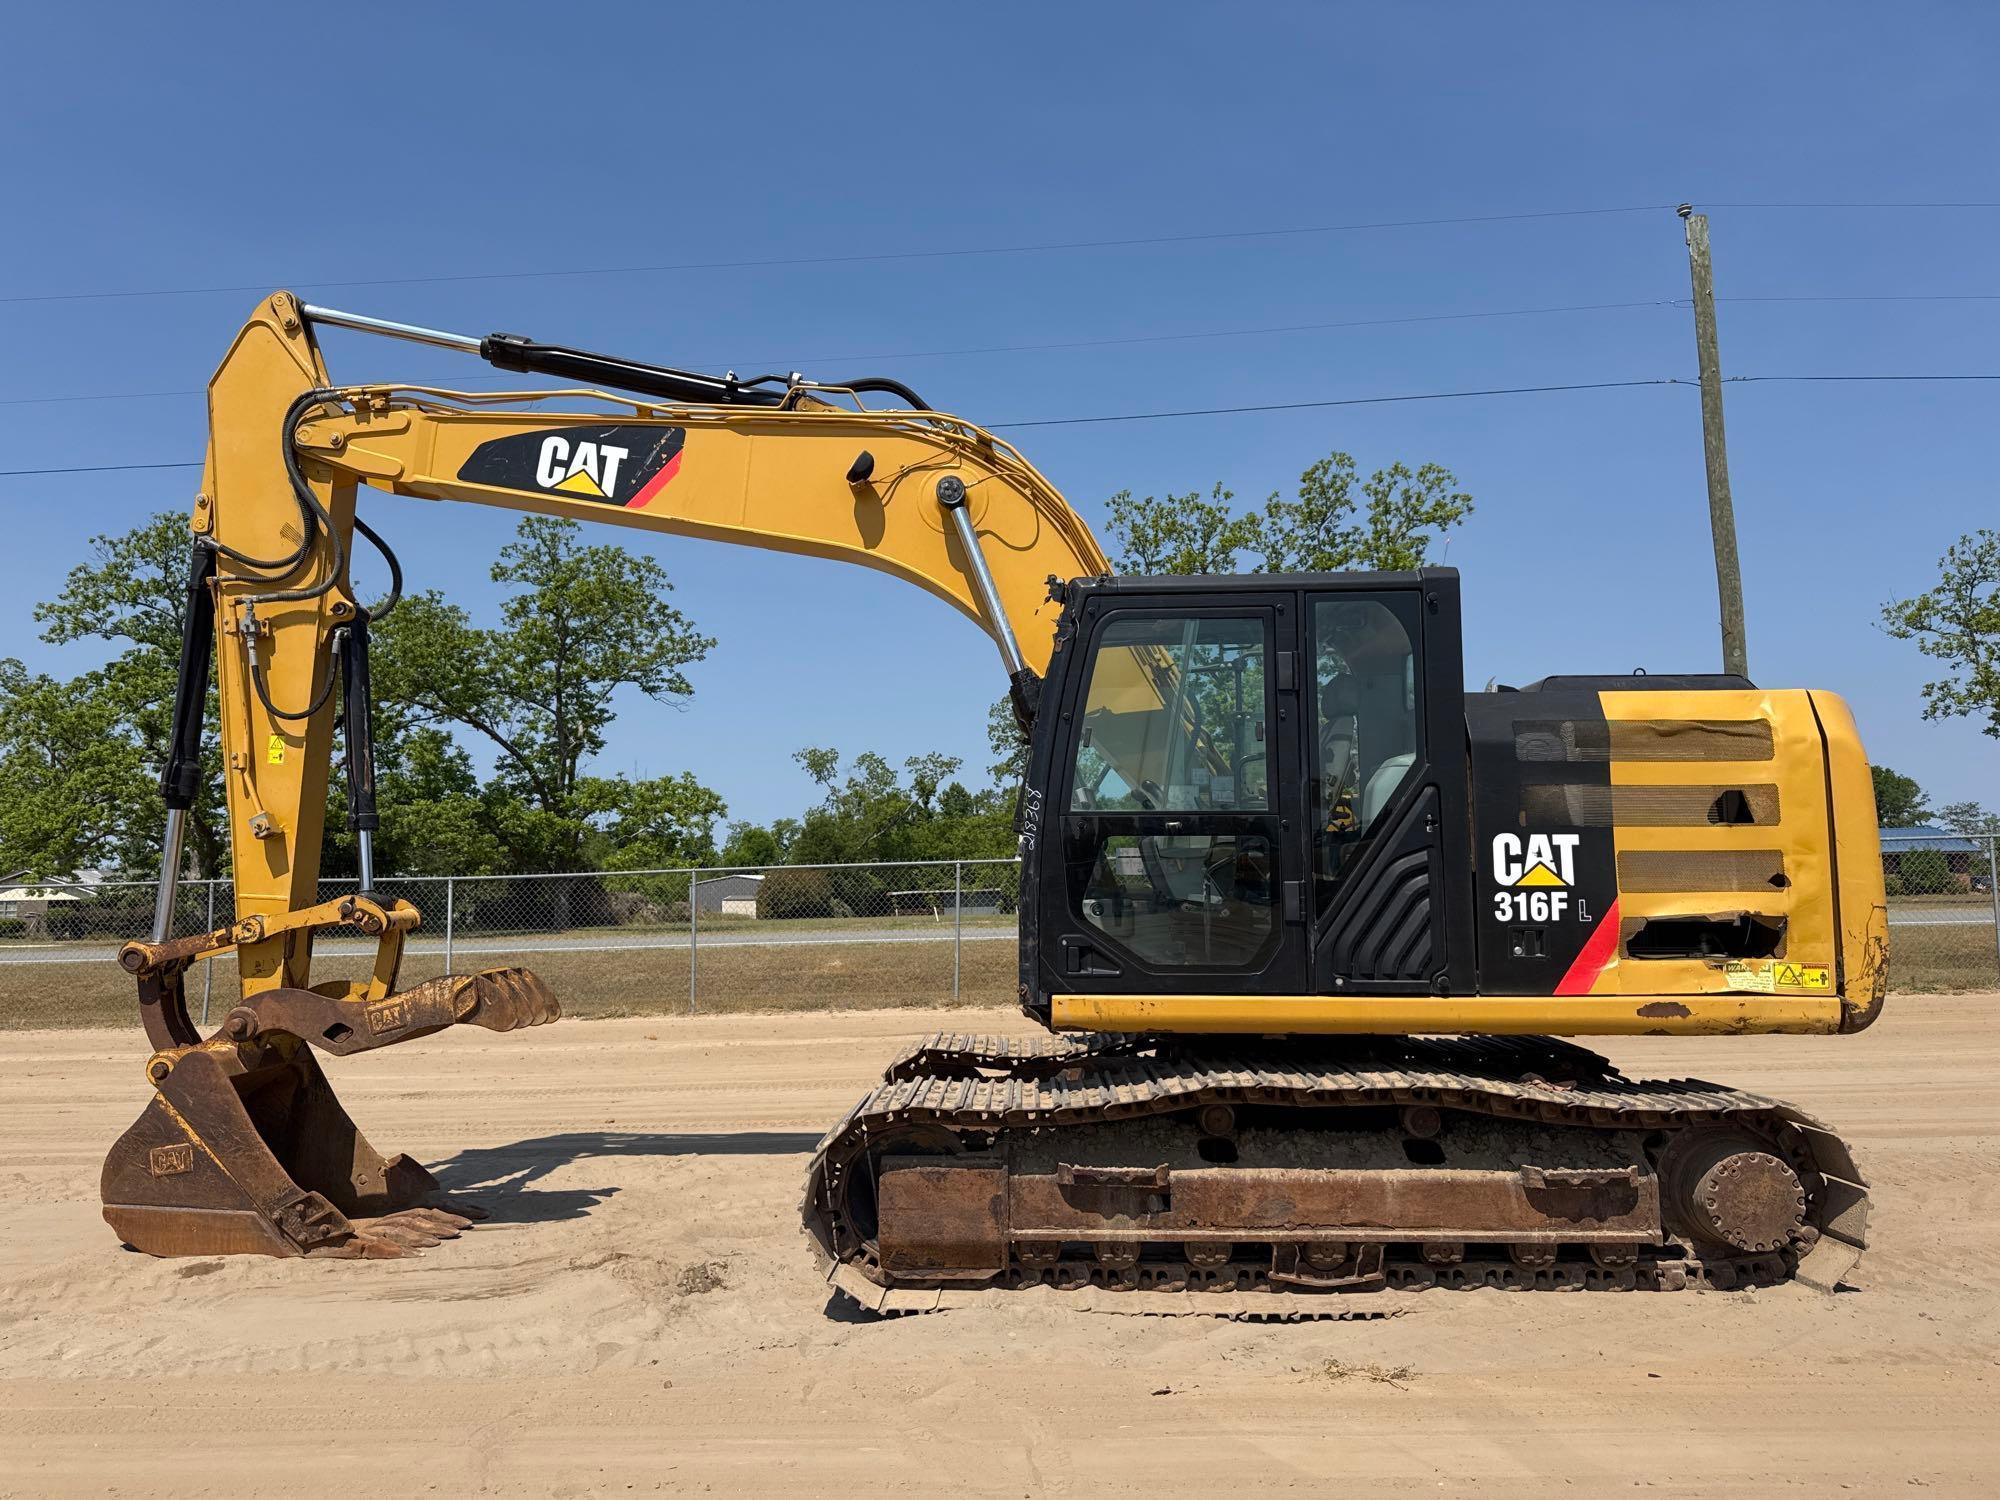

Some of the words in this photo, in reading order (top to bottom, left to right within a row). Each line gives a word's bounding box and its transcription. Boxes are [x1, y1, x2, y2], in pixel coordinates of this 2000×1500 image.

[536, 436, 628, 498] CAT
[1492, 833, 1580, 886] CAT
[1494, 891, 1568, 921] 316F
[1578, 899, 1592, 921] L
